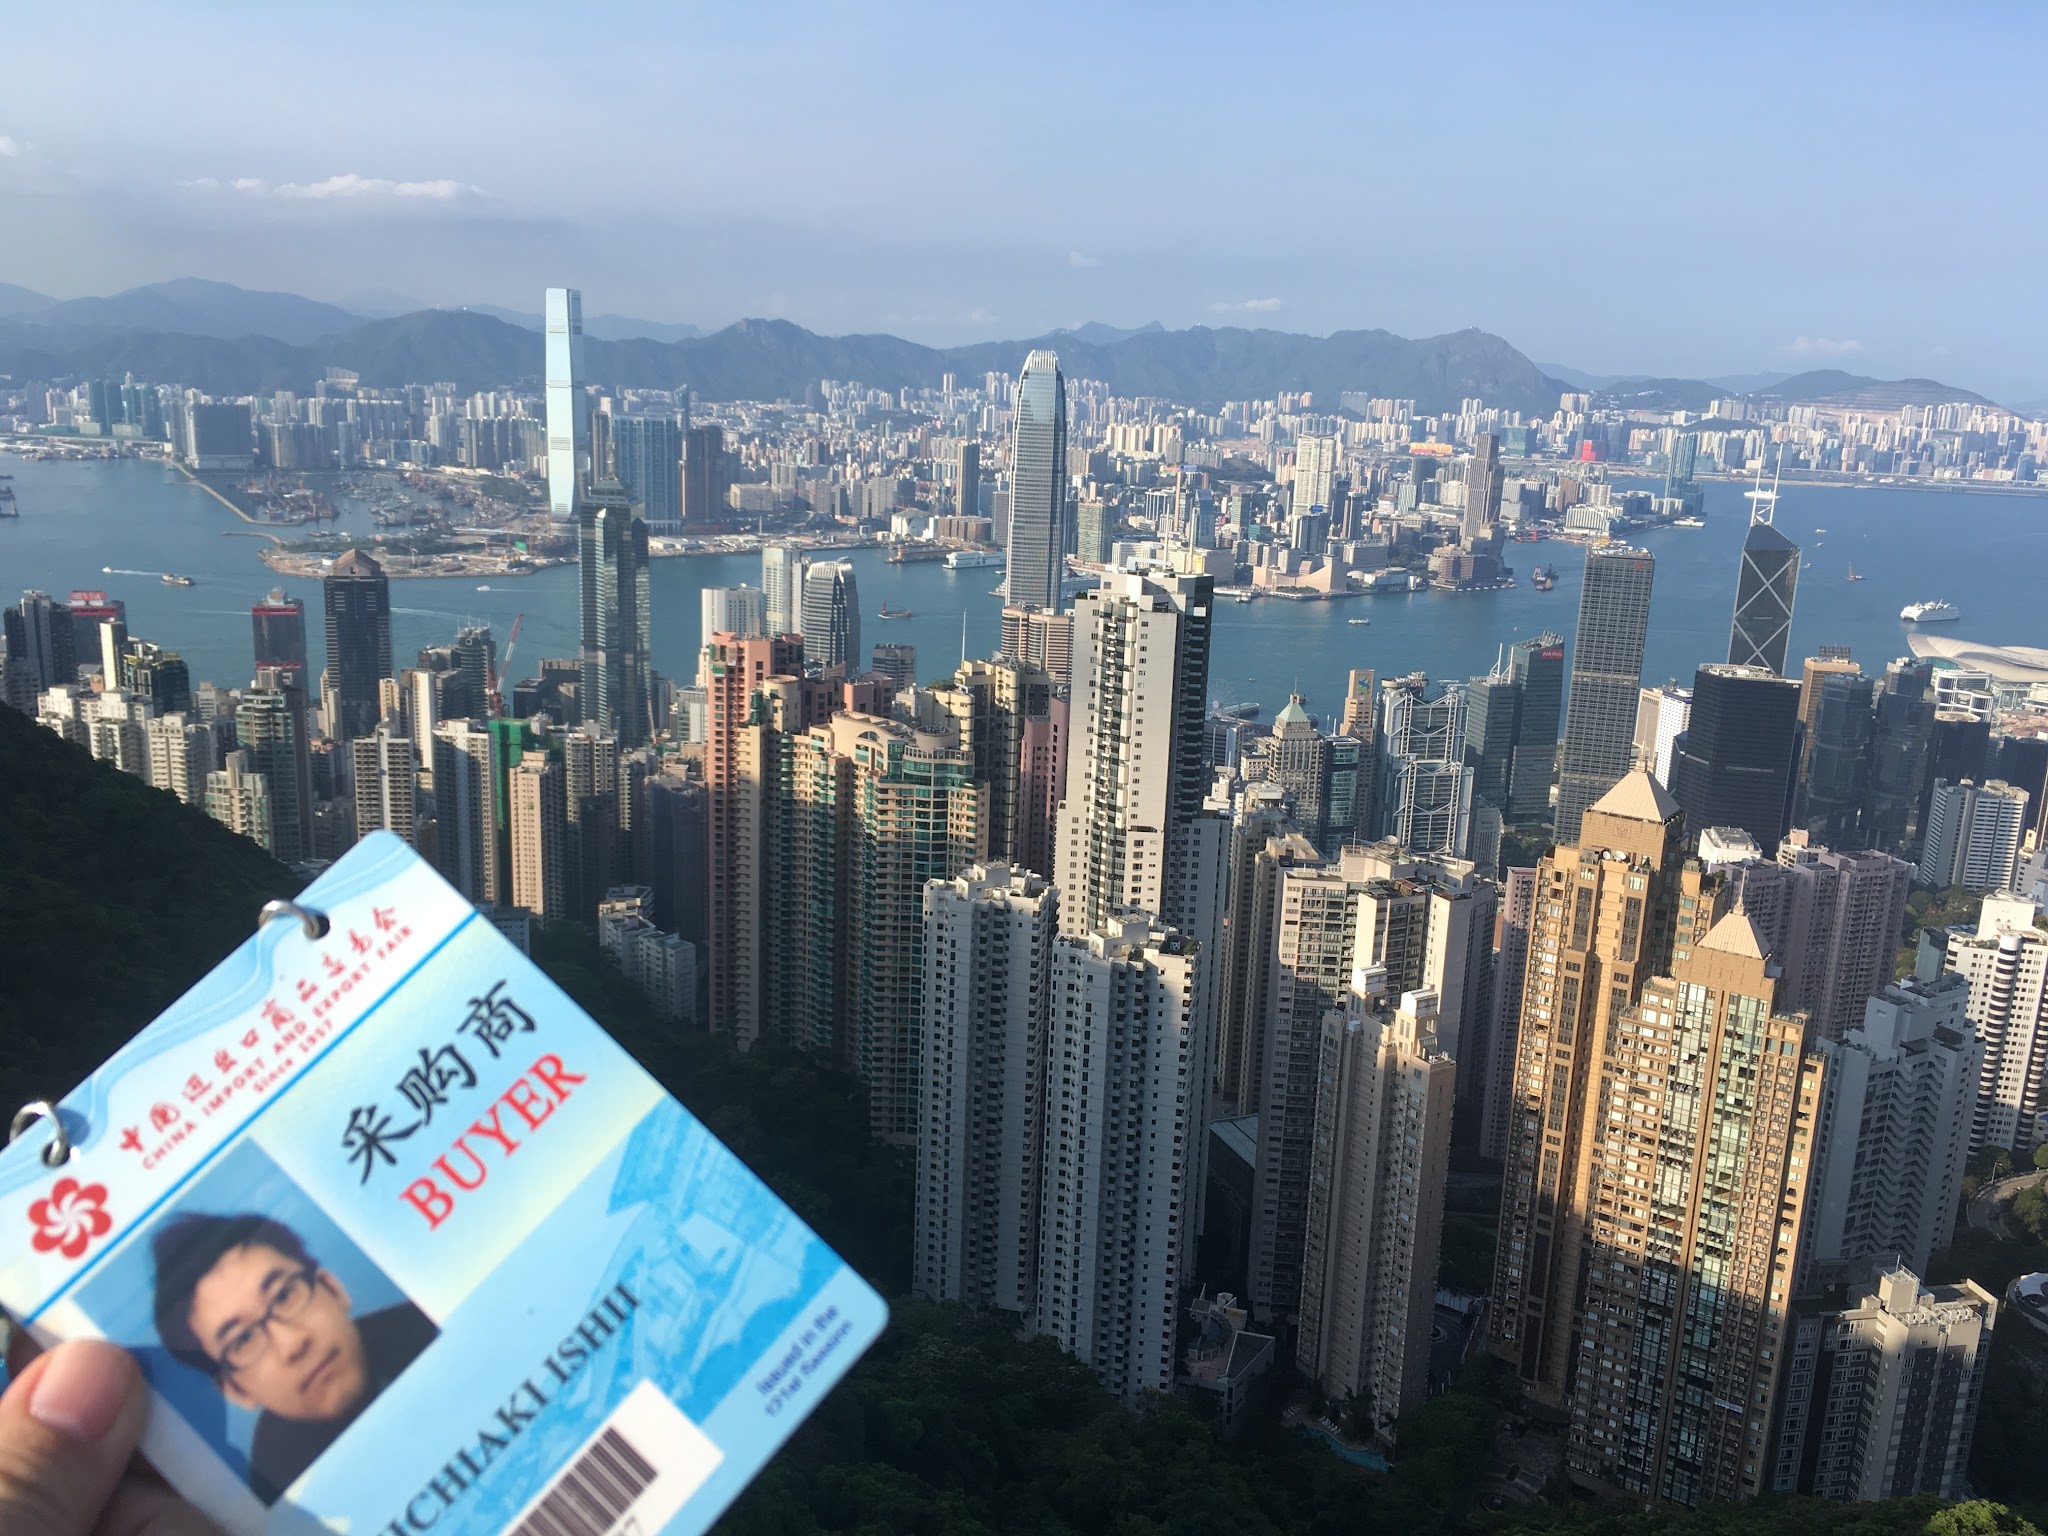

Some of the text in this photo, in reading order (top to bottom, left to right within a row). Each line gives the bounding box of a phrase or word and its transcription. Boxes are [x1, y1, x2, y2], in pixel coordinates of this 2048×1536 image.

[142, 925, 413, 1170] CHINA IMPORT AND EXPORT FAIR
[252, 1017, 333, 1094] Since 1957
[341, 978, 537, 1186] 采购商
[398, 1052, 588, 1232] BUYER
[378, 1281, 642, 1536] ICHIAKI ISHII
[812, 1304, 838, 1332] the
